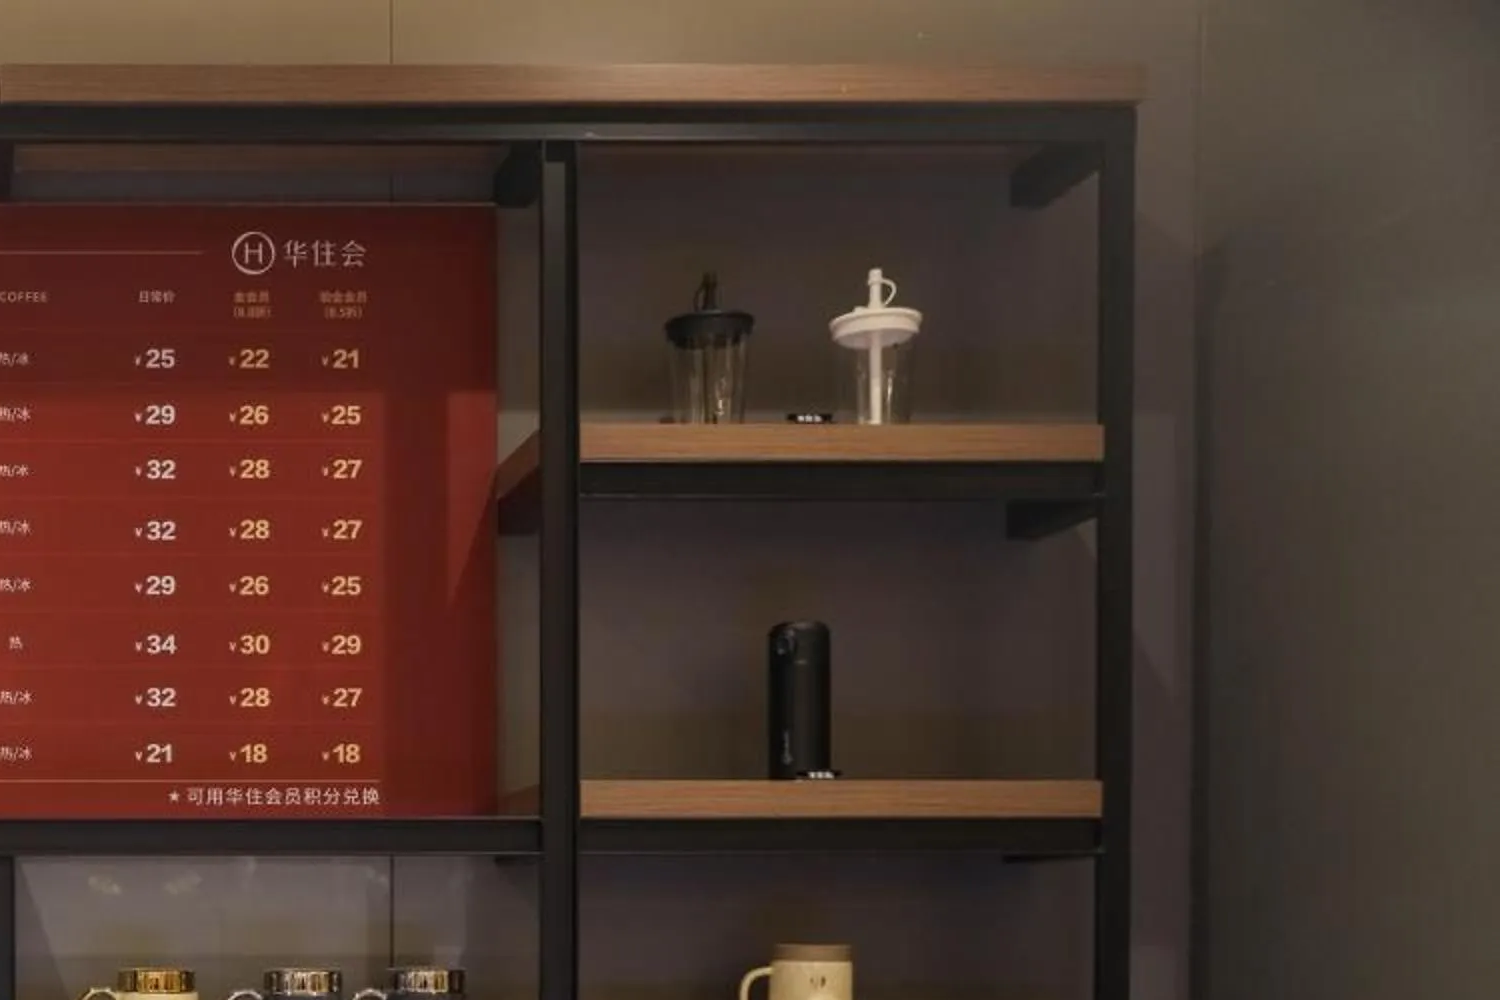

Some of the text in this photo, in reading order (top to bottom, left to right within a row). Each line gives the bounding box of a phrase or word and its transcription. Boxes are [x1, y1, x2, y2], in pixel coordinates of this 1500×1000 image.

[283, 239, 368, 269] 华住会
[187, 787, 380, 806] 可用华住会员积分兑换
